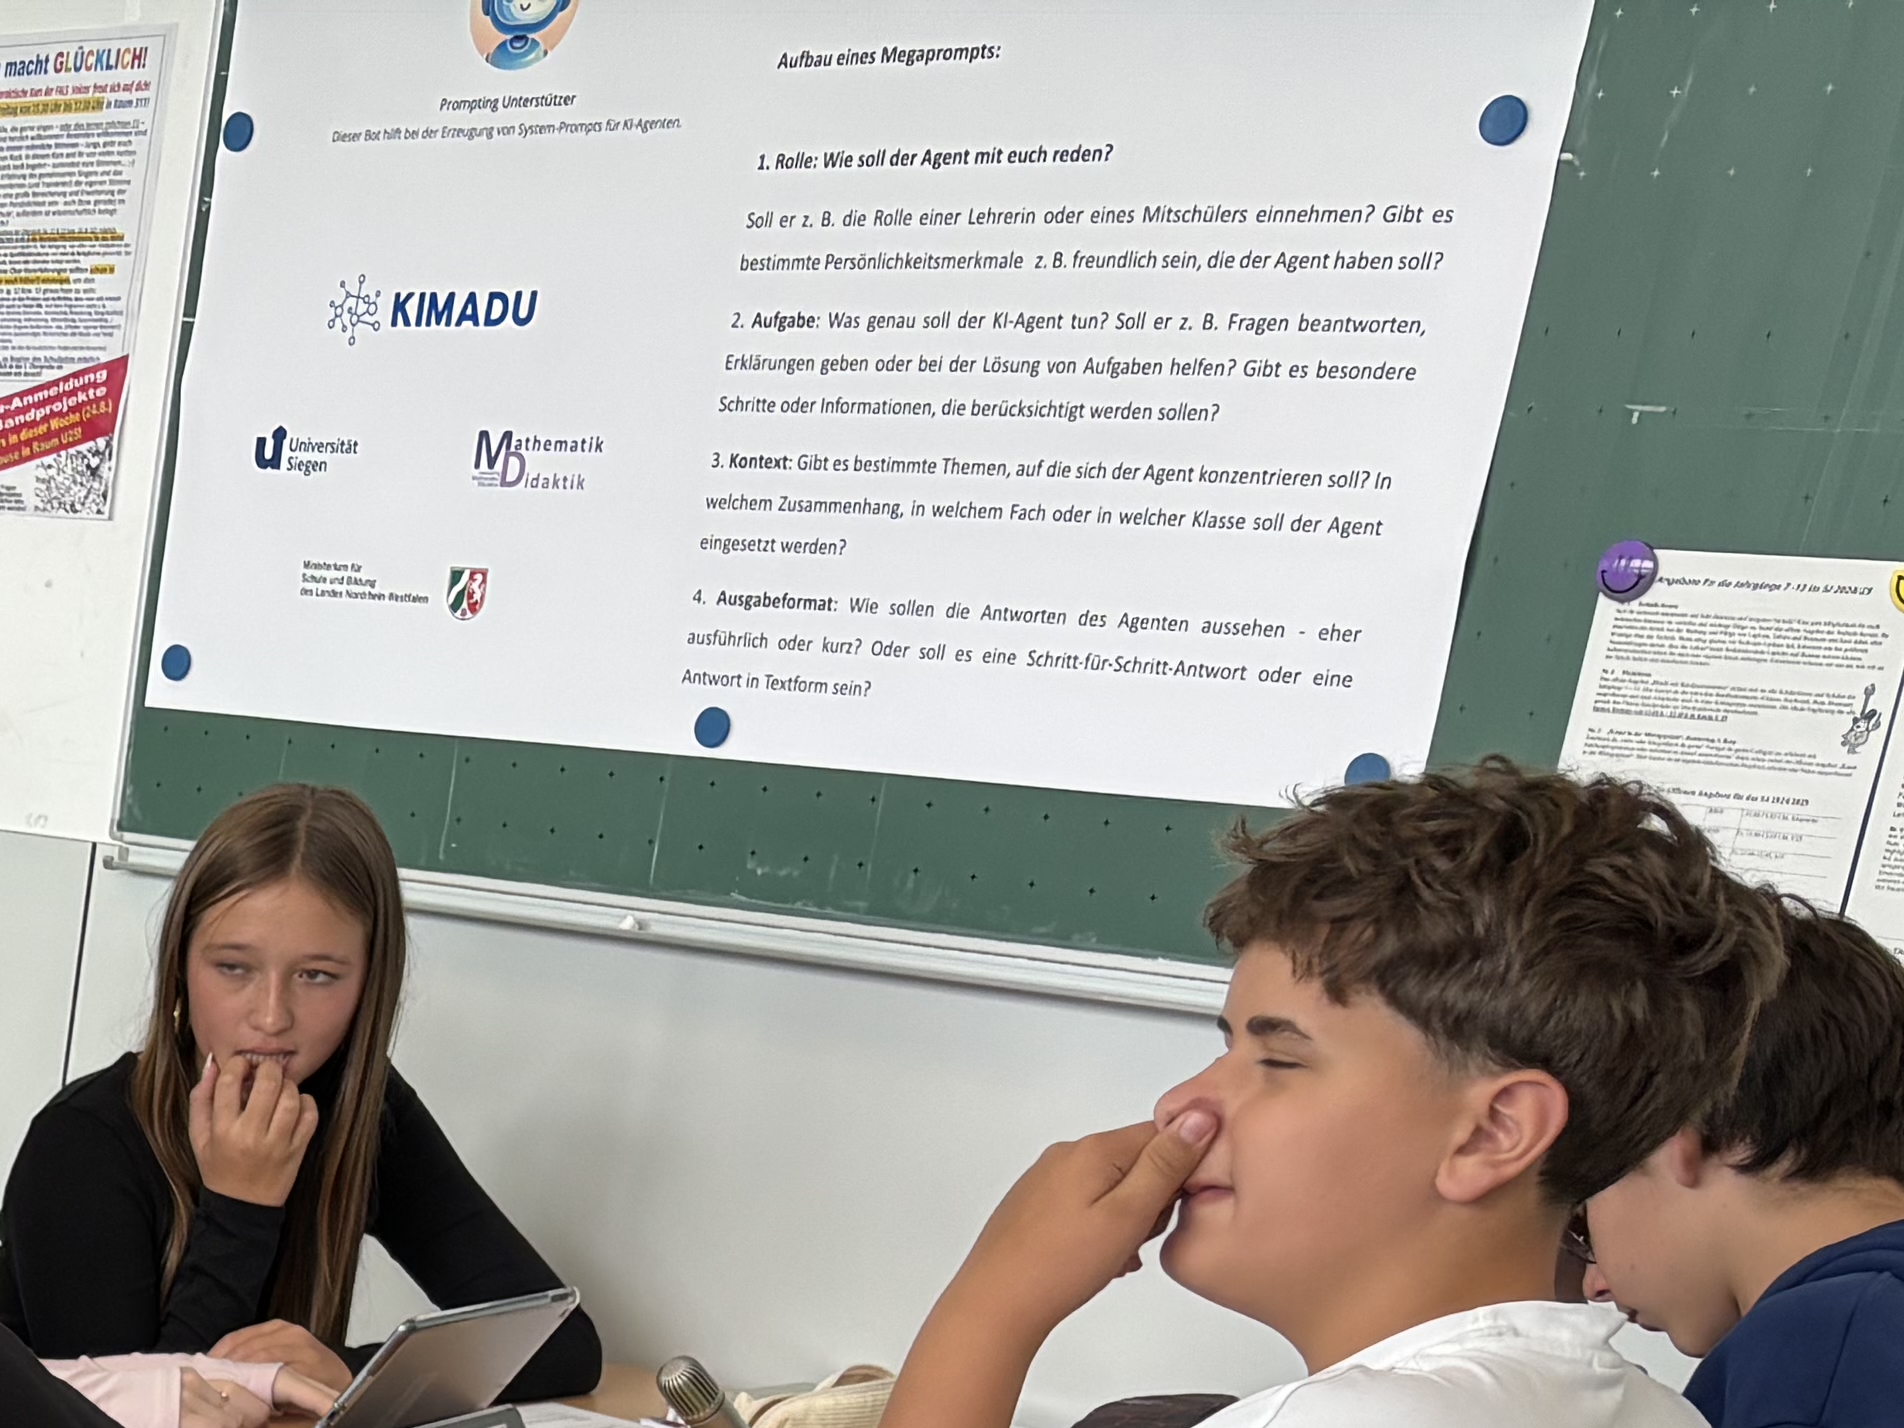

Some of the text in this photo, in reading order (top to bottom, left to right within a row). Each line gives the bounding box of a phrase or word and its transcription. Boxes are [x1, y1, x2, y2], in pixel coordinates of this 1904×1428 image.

[5, 53, 49, 77] macht
[53, 46, 149, 73] GLÜCKLICH!
[777, 44, 1001, 69] Aufbau eines Megaprompts:
[440, 93, 577, 114] Prompting Unterstützer
[757, 144, 1114, 170] 1. Rolle: Wie soll der Agent mit euch reden?
[746, 204, 1454, 229] Soll er z. B. die Rolle einer Lehrerin oder eines Mitschülers einnehmen? Gibt es
[740, 249, 1444, 273] bestimmte Persönlichkeitsmerkmale z. B. freundlich sein, die der Agent haben soll?
[391, 289, 539, 328] KIMADU
[731, 310, 1425, 337] 2. Aufgabe: Was genau soll der KI-Agent tun? Soll er z. B. Fragen beantworten,
[725, 354, 1416, 381] Erklärungen geben oder bei der Lösung von Aufgaben helfen? Gibt es besondere
[718, 395, 1220, 422] Schritte oder Informationen, die berücksichtigt werden sollen?
[20, 423, 48, 442] dieser
[50, 413, 81, 431] Woche
[33, 438, 60, 454] Raum
[288, 437, 359, 455] Universität
[474, 429, 604, 470] Mathematik
[286, 456, 328, 477] Siegen
[499, 449, 585, 491] Didaktik
[681, 669, 871, 697] Antwort in Textform sein?
